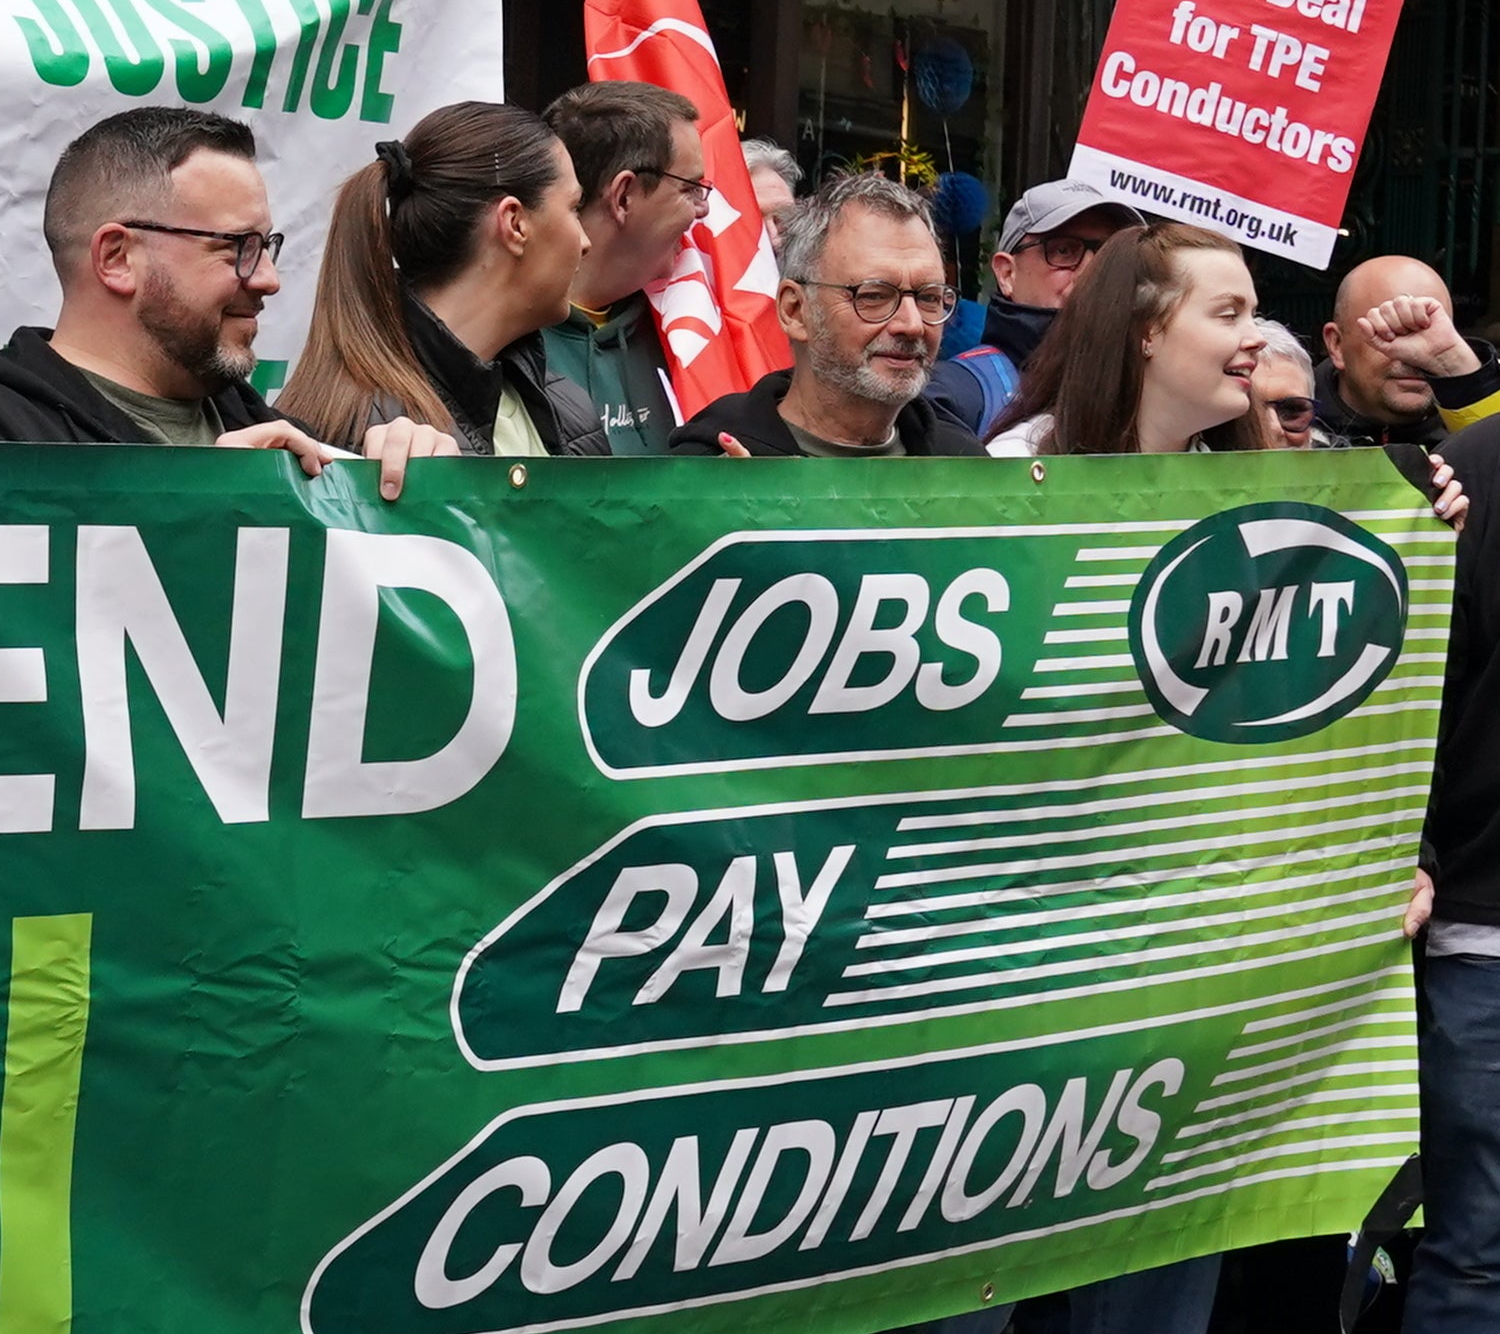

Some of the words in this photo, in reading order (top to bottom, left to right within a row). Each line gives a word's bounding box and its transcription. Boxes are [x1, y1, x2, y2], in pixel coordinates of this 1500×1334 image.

[1169, 1, 1239, 61] for
[1248, 24, 1331, 93] TPE
[1101, 52, 1357, 174] Conductors
[1109, 169, 1299, 248] www.rmt.org.uk
[628, 567, 1011, 729] JOBS
[1199, 579, 1356, 671] RMT
[555, 844, 855, 1015] PAY
[413, 1057, 1185, 1312] CONDITIONS
